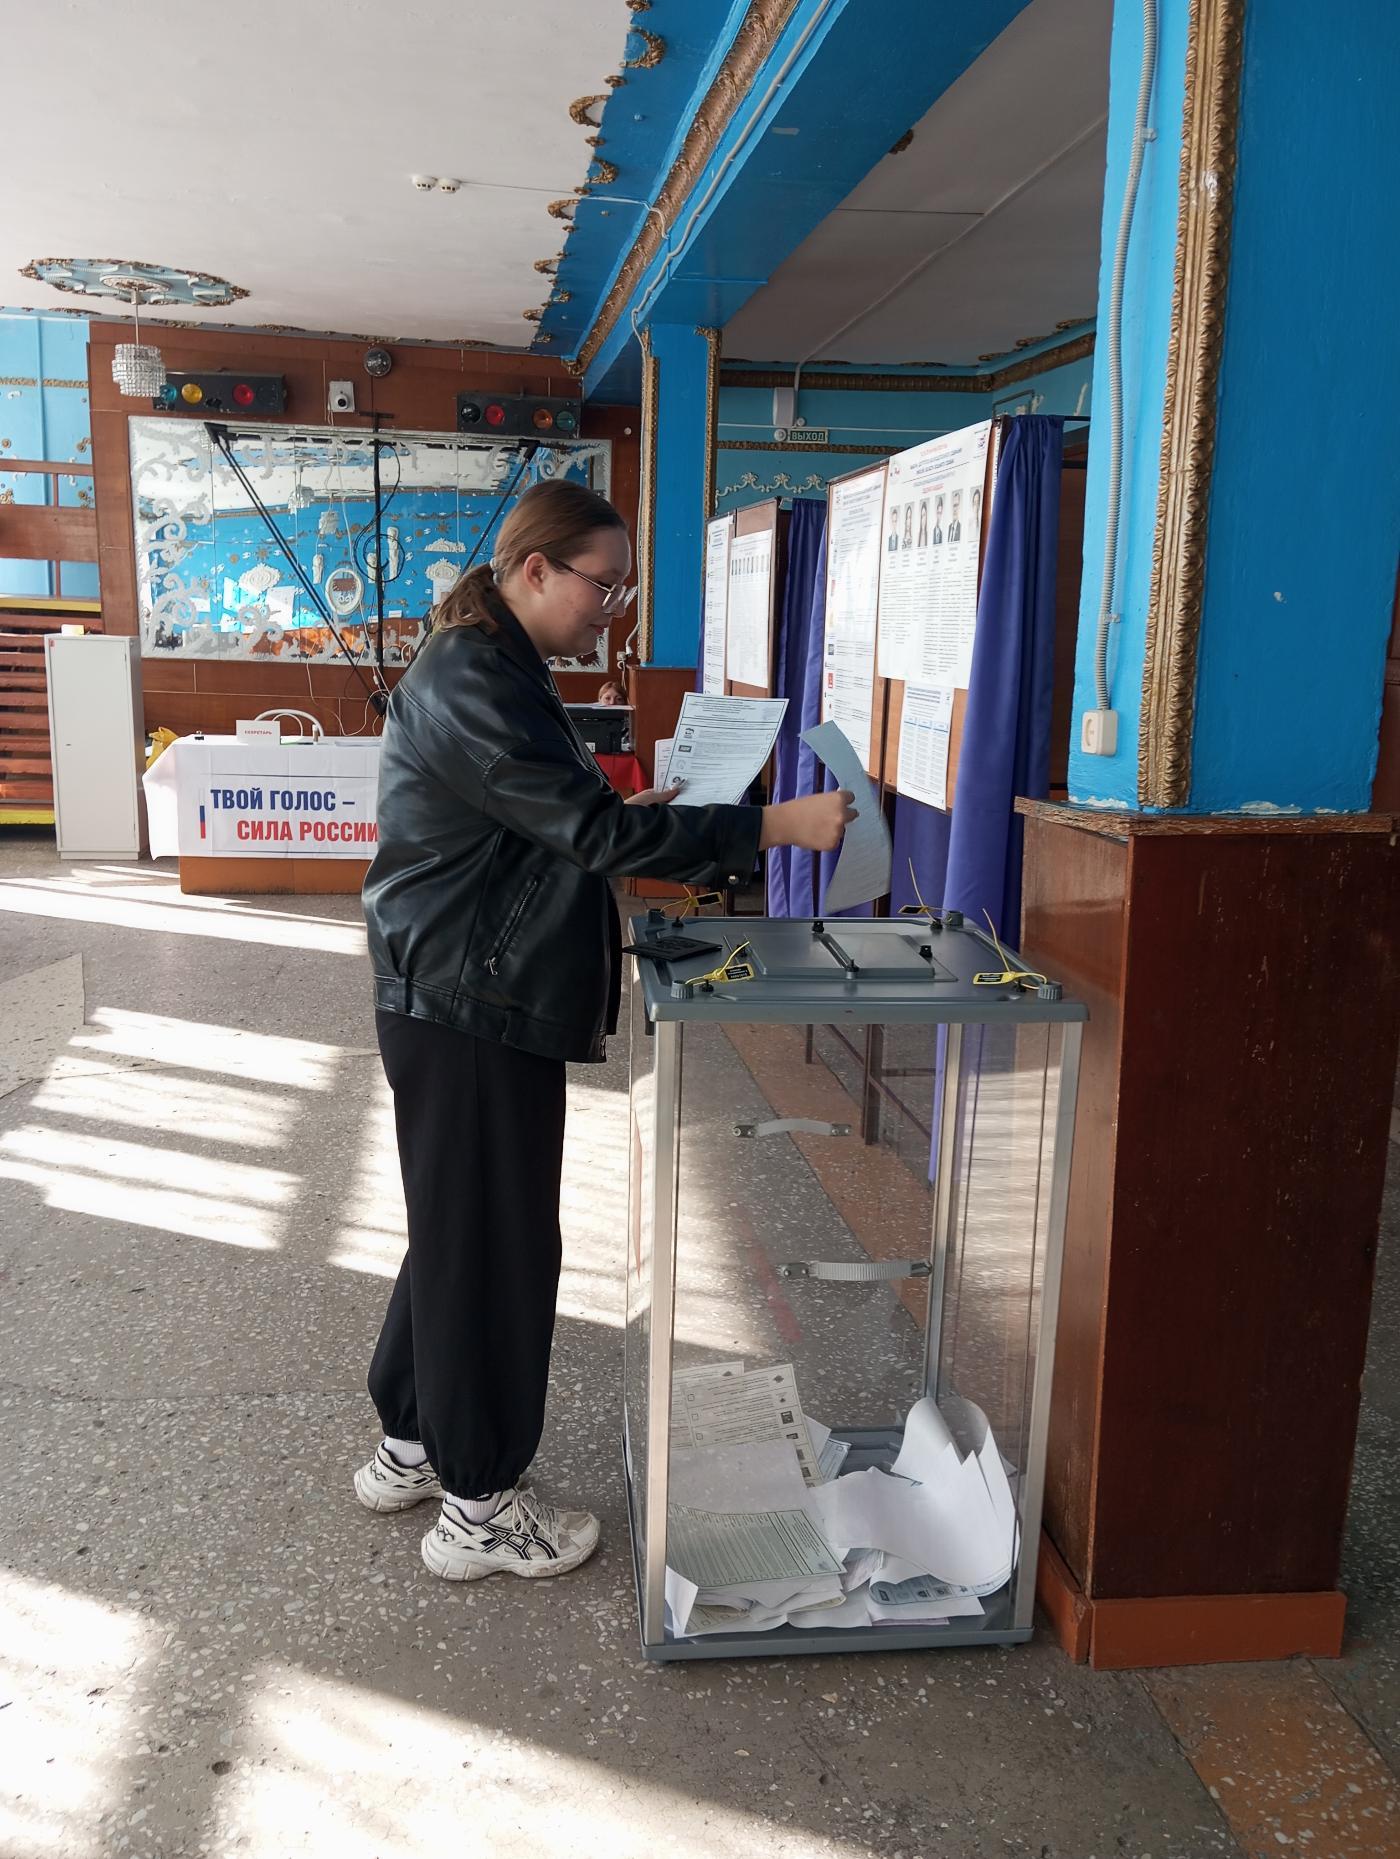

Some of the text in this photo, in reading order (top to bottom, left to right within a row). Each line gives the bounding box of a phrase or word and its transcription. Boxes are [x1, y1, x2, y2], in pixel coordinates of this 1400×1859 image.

[791, 432, 825, 441] ВЫХОД
[210, 787, 263, 810] ТВОЙ
[270, 790, 336, 811] ГОЛОС
[237, 820, 378, 842] СИЛА РОССИИ
